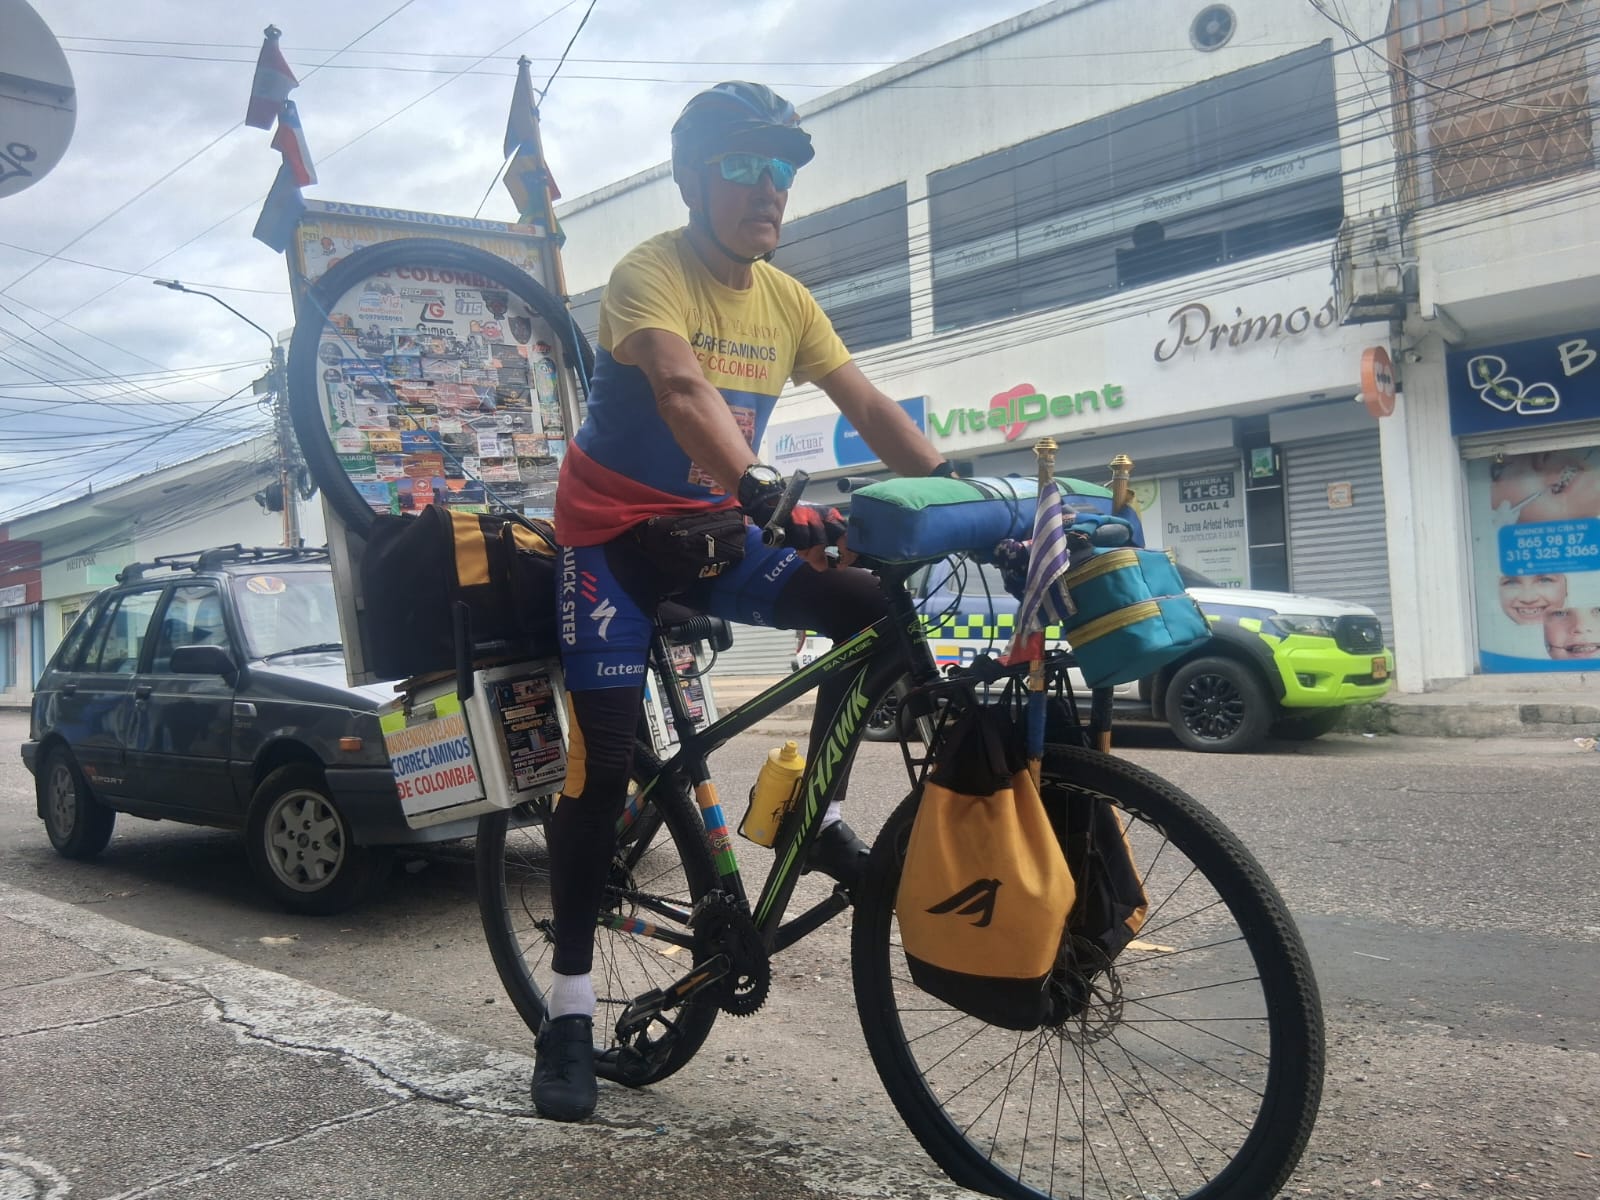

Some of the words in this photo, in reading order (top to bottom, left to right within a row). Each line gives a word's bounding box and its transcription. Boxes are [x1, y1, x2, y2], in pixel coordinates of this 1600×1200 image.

[324, 201, 508, 233] PATROCINADORES
[928, 383, 1126, 438] VitalDent
[788, 433, 824, 453] Actuar
[1183, 484, 1230, 499] 11-65
[1185, 501, 1220, 513] LOCAL
[1222, 500, 1230, 509] 4
[1506, 549, 1531, 562] 315
[1535, 547, 1561, 560] 325
[1565, 544, 1599, 557] 3065
[1517, 536, 1543, 549] 865
[1546, 534, 1564, 546] 98
[1567, 532, 1585, 545] 87
[763, 549, 800, 583] late
[823, 637, 874, 672] SAVAGE
[391, 736, 471, 778] CORRECAMINOS
[395, 780, 413, 800] DE
[414, 764, 477, 796] COLOMBIA
